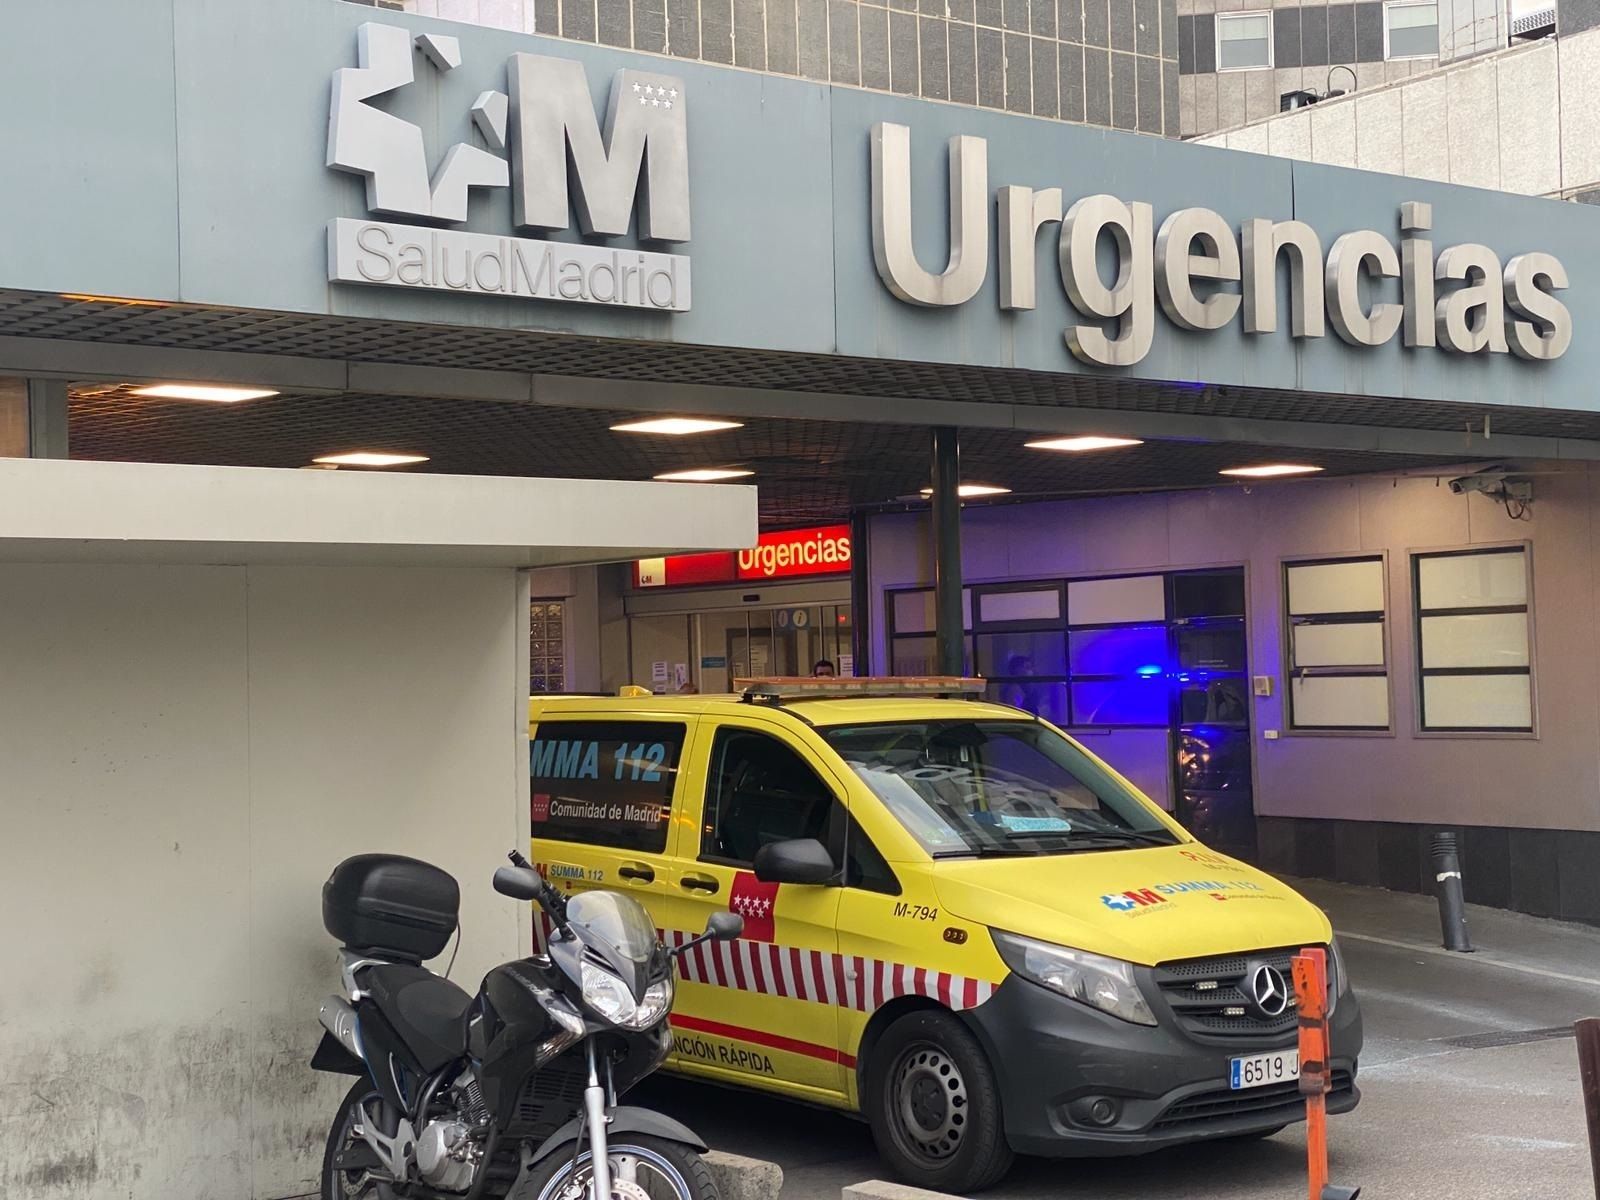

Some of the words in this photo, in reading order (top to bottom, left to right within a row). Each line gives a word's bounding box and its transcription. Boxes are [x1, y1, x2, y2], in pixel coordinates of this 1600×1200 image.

[507, 51, 692, 243] M
[870, 121, 1572, 366] Urgencias
[355, 224, 677, 308] SaludMadrid
[738, 532, 851, 576] Urgencias
[614, 742, 665, 782] 112
[550, 800, 607, 819] Comunidad
[608, 804, 622, 820] de
[624, 804, 662, 823] Madrid
[550, 864, 585, 879] SUMMA
[588, 869, 604, 881] 112
[1154, 881, 1232, 894] SUMMA
[893, 901, 939, 922] M-794
[672, 1035, 717, 1061] NCIÓN
[718, 1042, 775, 1075] RÁPIDA
[1244, 1056, 1283, 1084] 6519
